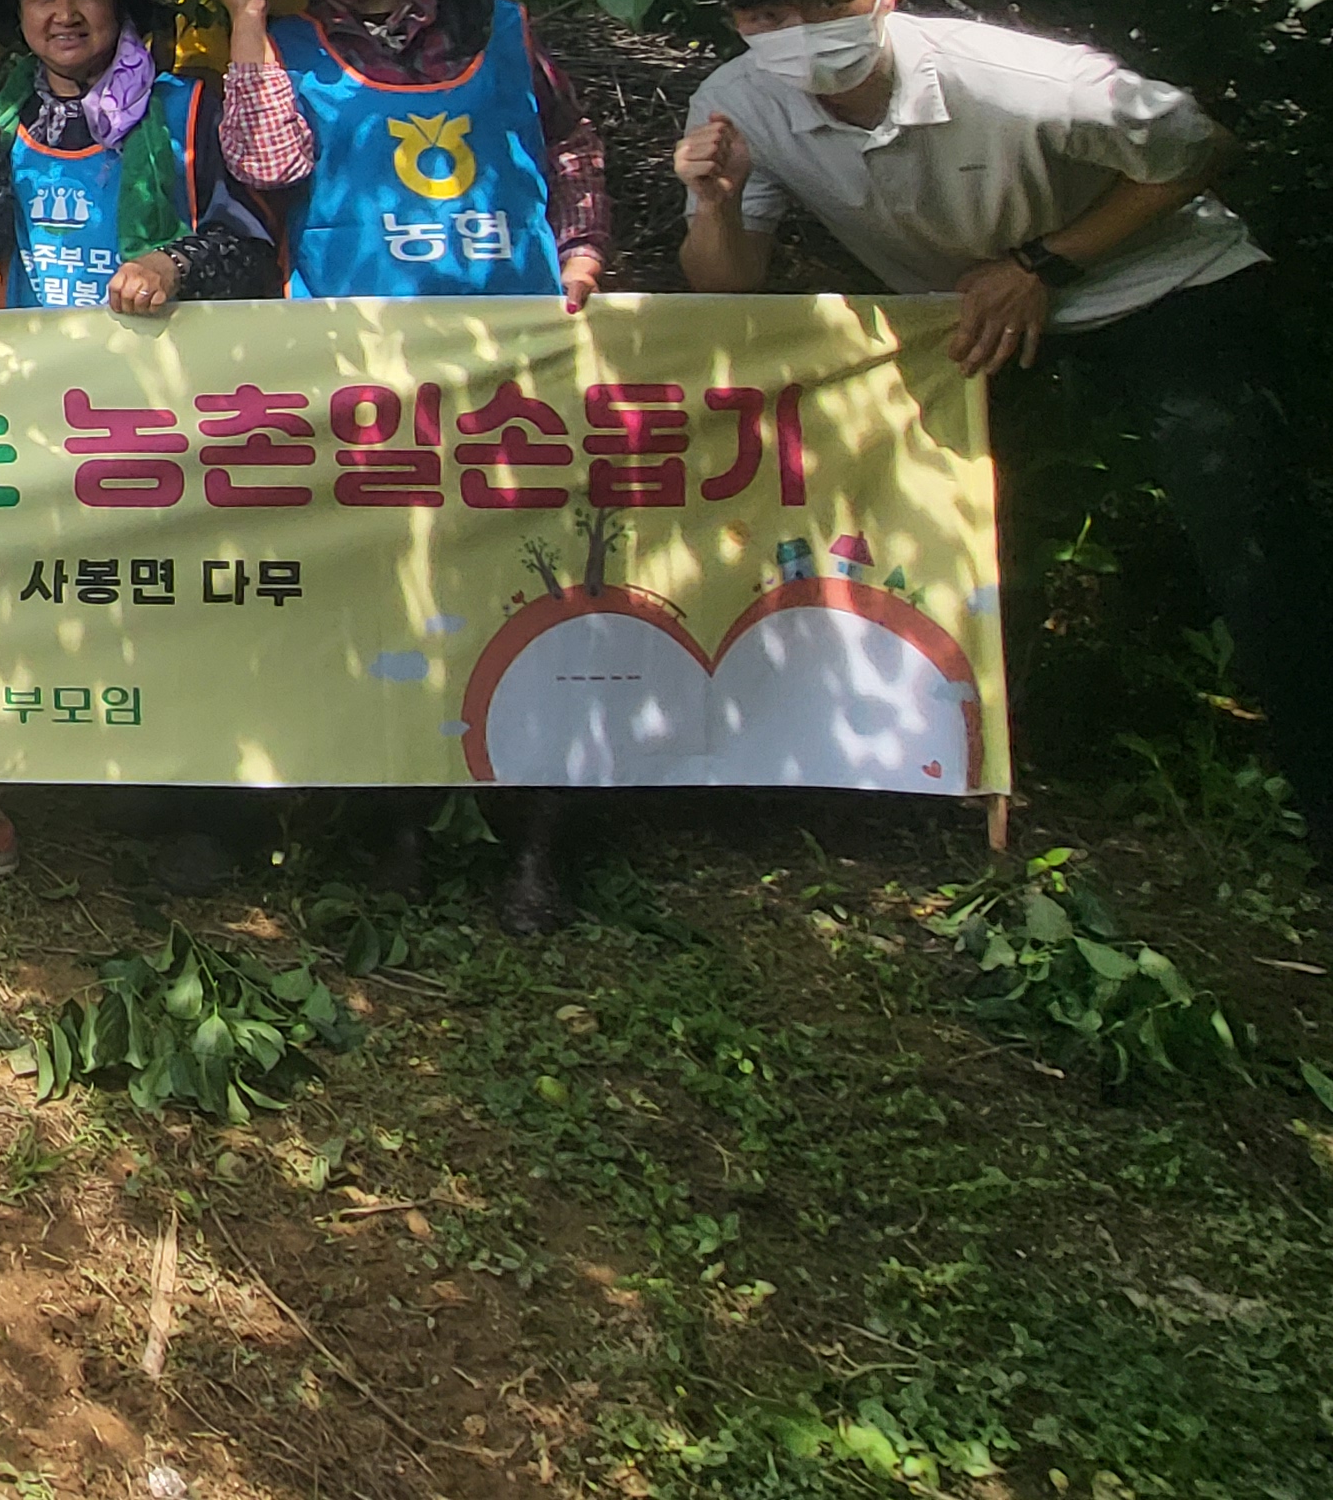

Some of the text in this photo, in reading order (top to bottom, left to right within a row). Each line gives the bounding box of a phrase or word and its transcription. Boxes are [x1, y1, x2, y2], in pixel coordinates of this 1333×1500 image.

[381, 208, 511, 263] 농협
[63, 382, 808, 510] 농촌일손돕기
[20, 558, 177, 606] 사봉면
[201, 559, 304, 607] 다무
